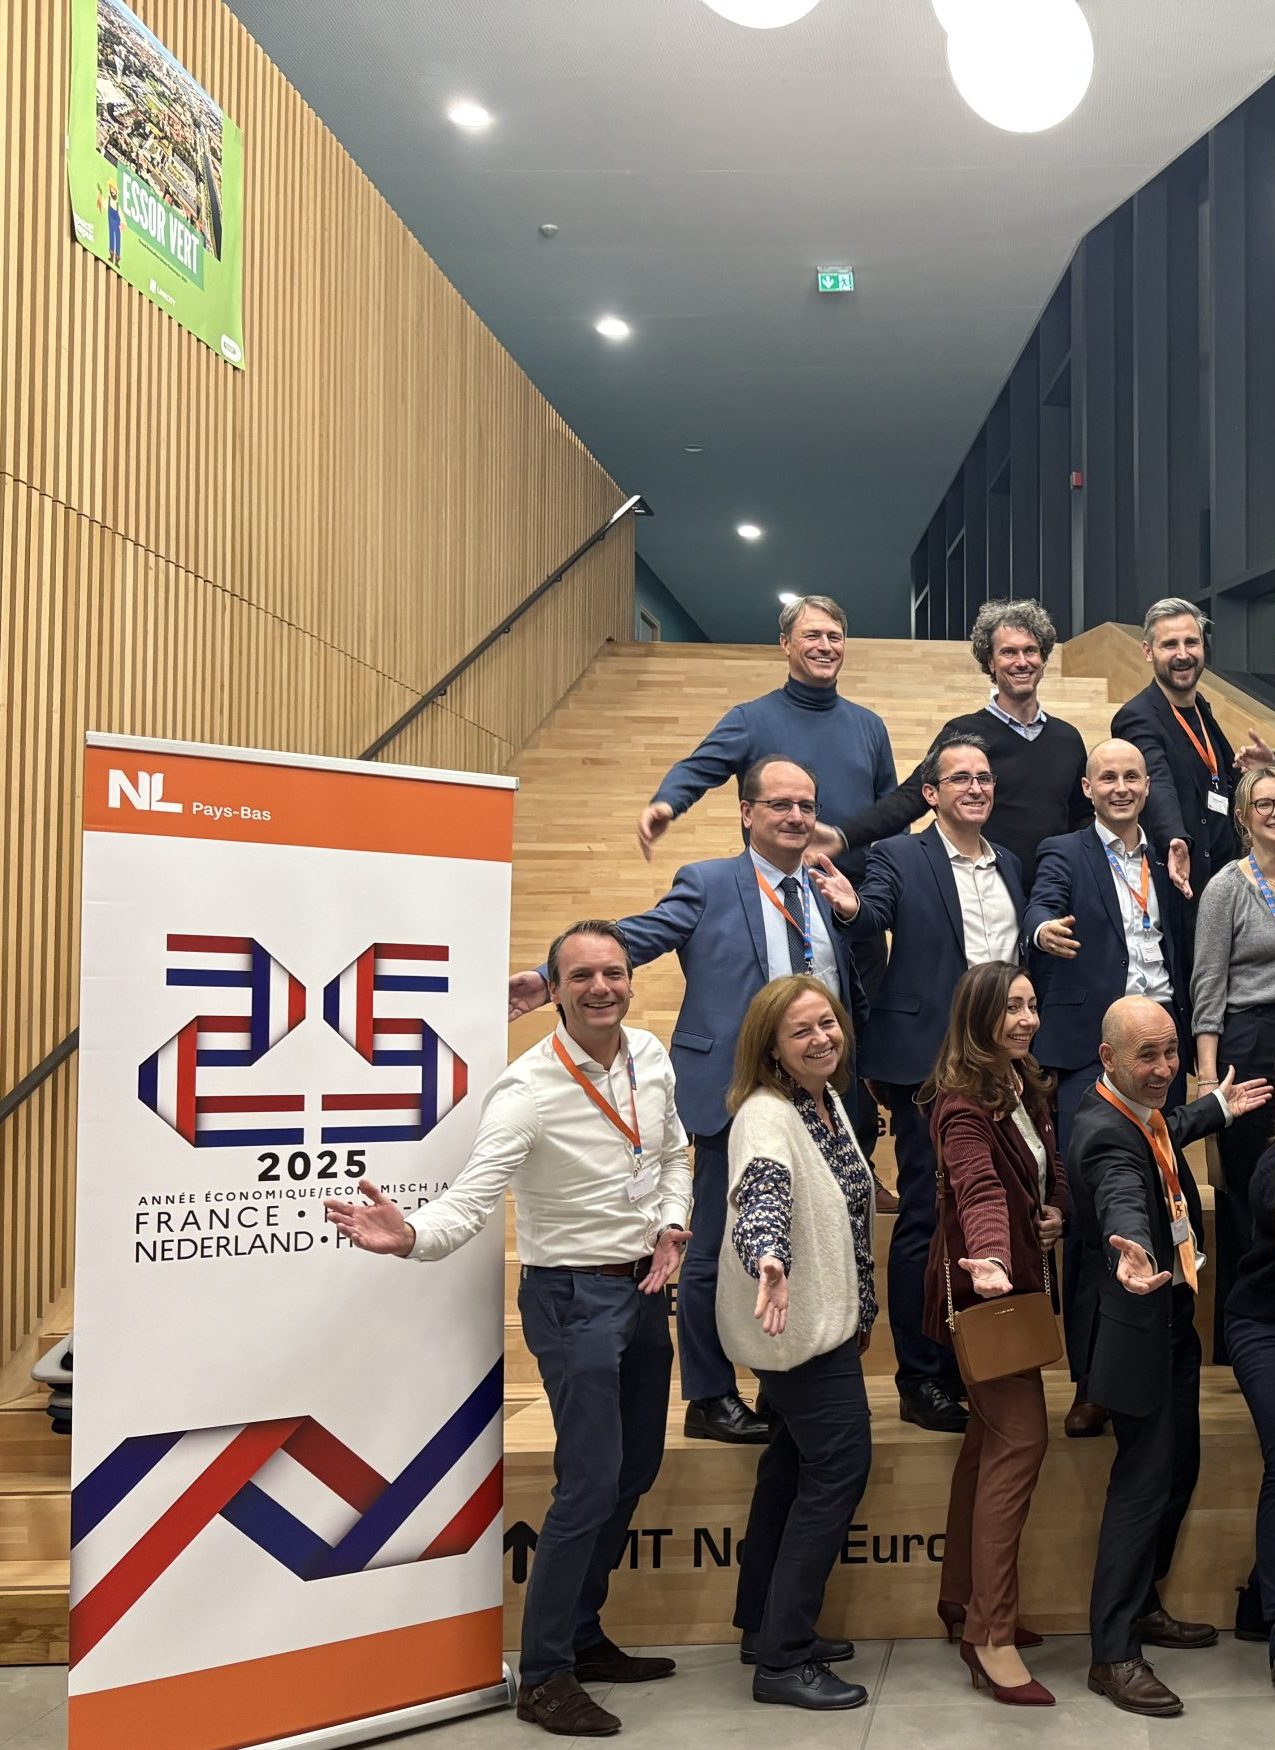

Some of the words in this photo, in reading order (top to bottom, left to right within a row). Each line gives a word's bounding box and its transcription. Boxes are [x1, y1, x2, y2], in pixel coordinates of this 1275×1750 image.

[122, 171, 166, 247] ESSOR
[169, 213, 200, 275] VERT
[108, 768, 183, 813] NL
[192, 802, 271, 821] Pays-Bas
[257, 1150, 367, 1182] 2025
[138, 1192, 196, 1206] ANNÉE
[135, 1205, 280, 1235] FRANCE
[135, 1230, 313, 1263] NEDERLAND
